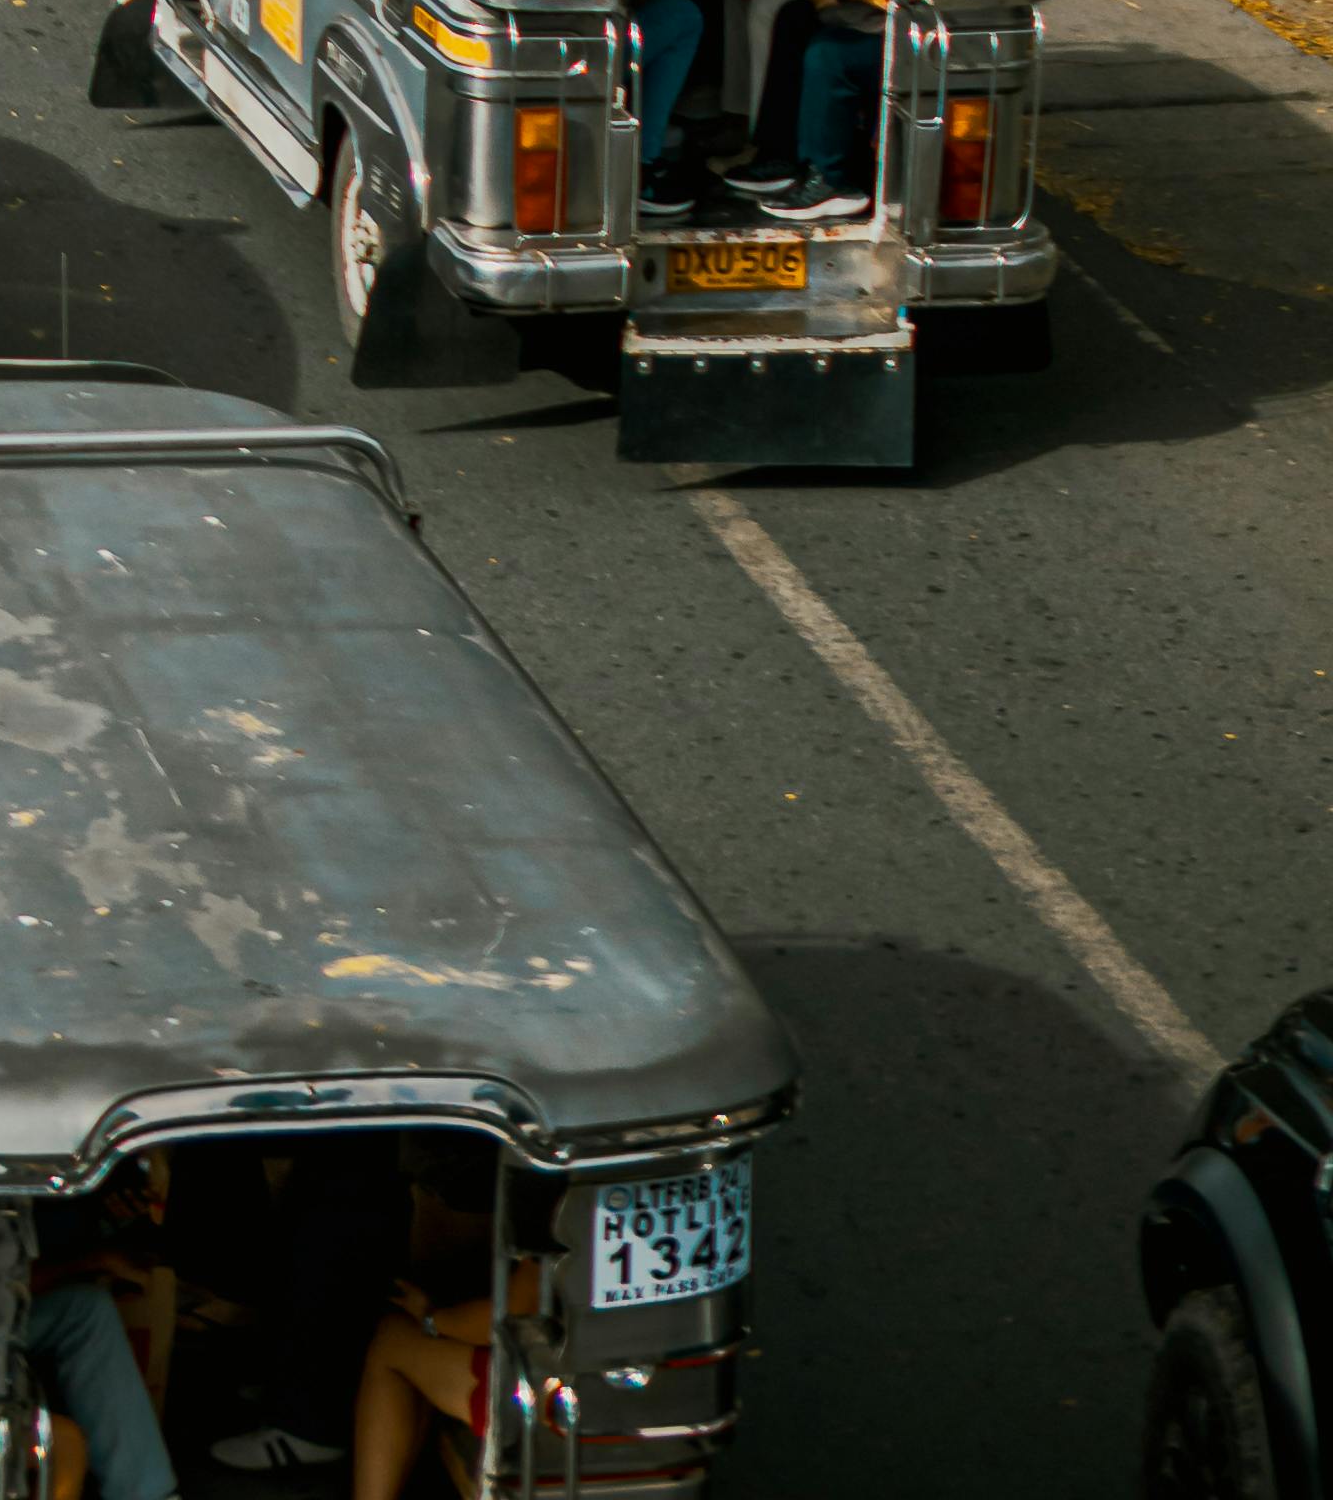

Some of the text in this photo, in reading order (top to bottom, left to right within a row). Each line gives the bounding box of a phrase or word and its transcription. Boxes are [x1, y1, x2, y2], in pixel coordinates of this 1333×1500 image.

[673, 244, 800, 275] DXU 506
[634, 1174, 713, 1210] LTFRB
[609, 1216, 746, 1286] 1342
